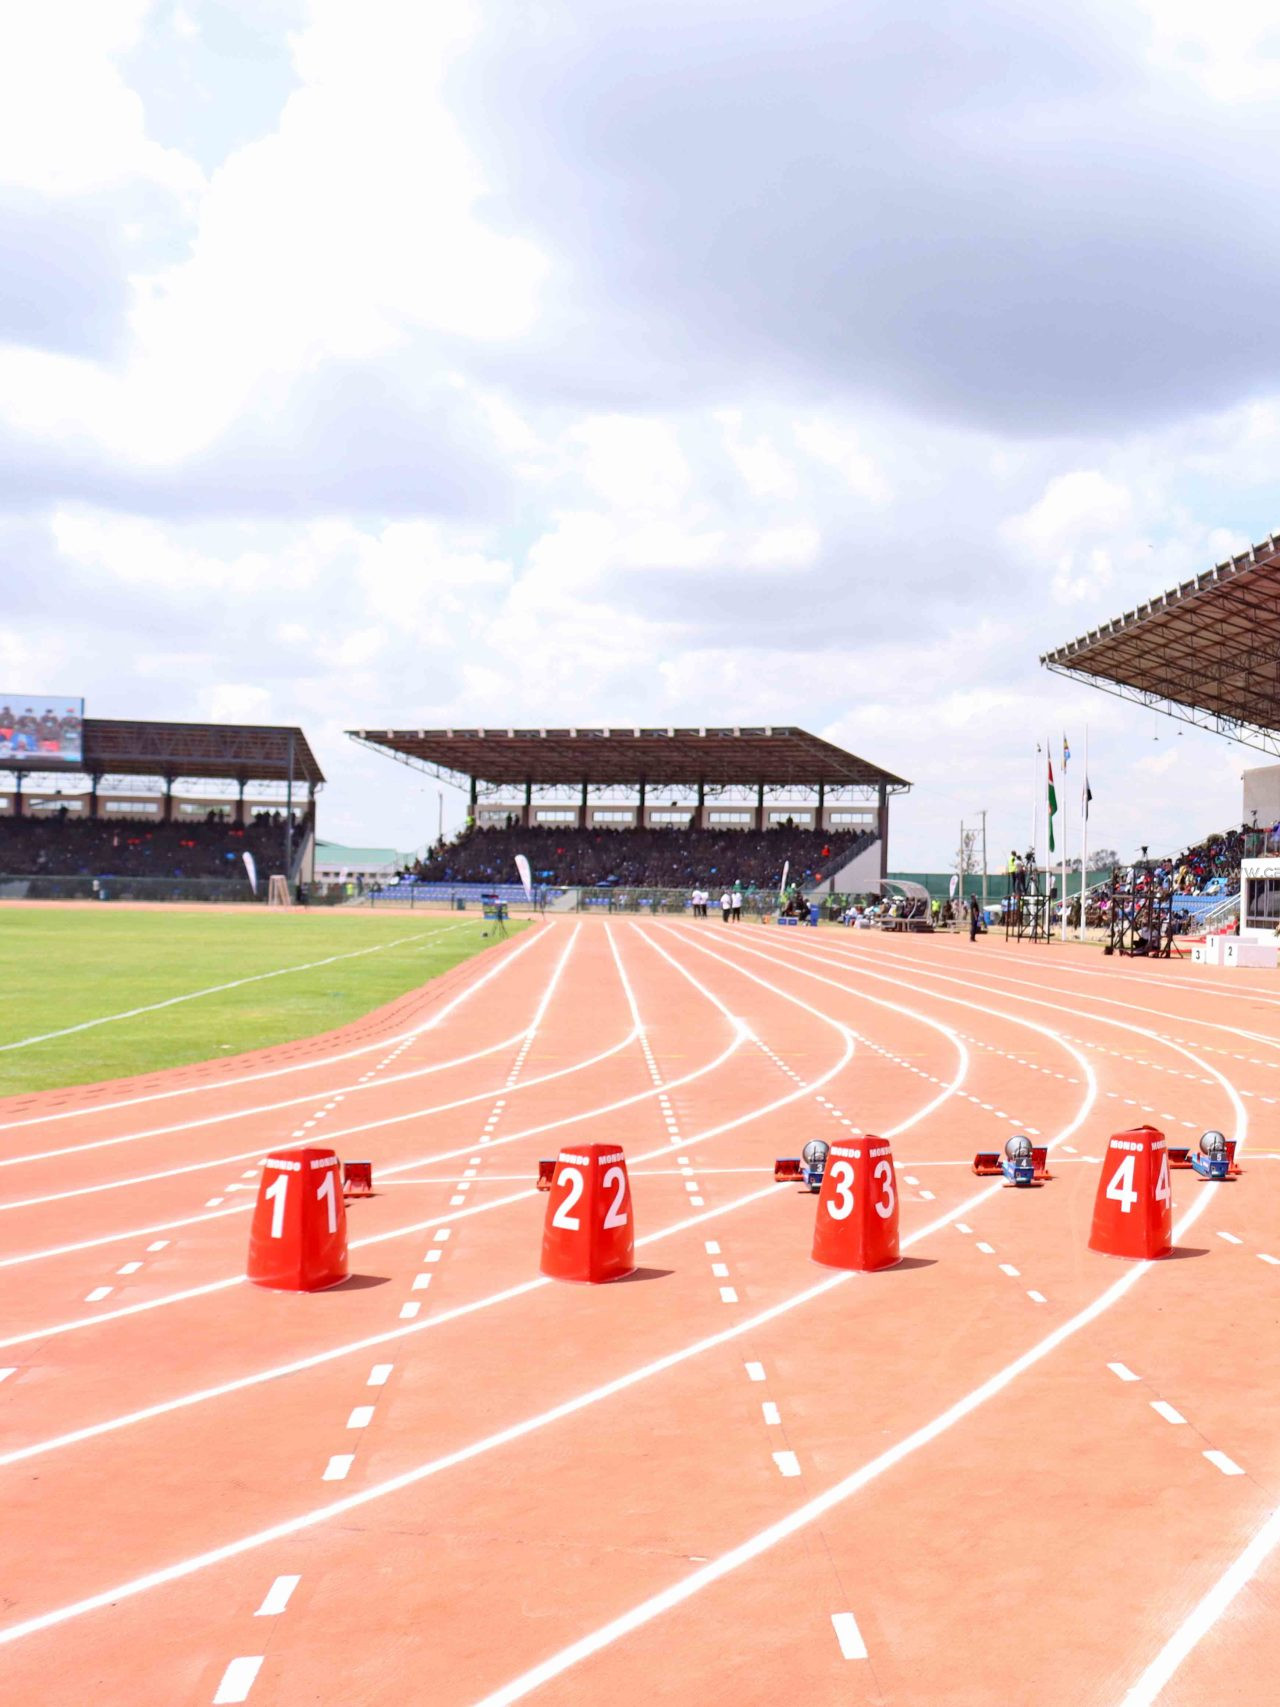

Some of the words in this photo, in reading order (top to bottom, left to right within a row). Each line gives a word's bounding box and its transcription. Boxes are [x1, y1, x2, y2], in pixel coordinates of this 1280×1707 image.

[1195, 950, 1200, 960] 3
[1228, 946, 1233, 956] 2
[817, 1163, 823, 1172] 3
[827, 1160, 854, 1220] 3
[873, 1160, 894, 1219] 3
[1021, 1158, 1027, 1168] 4
[1106, 1155, 1137, 1213] 4
[1155, 1152, 1171, 1209] 4
[265, 1174, 289, 1239] 1
[316, 1170, 338, 1234] 1
[552, 1167, 584, 1231] 2
[602, 1166, 628, 1230] 2
